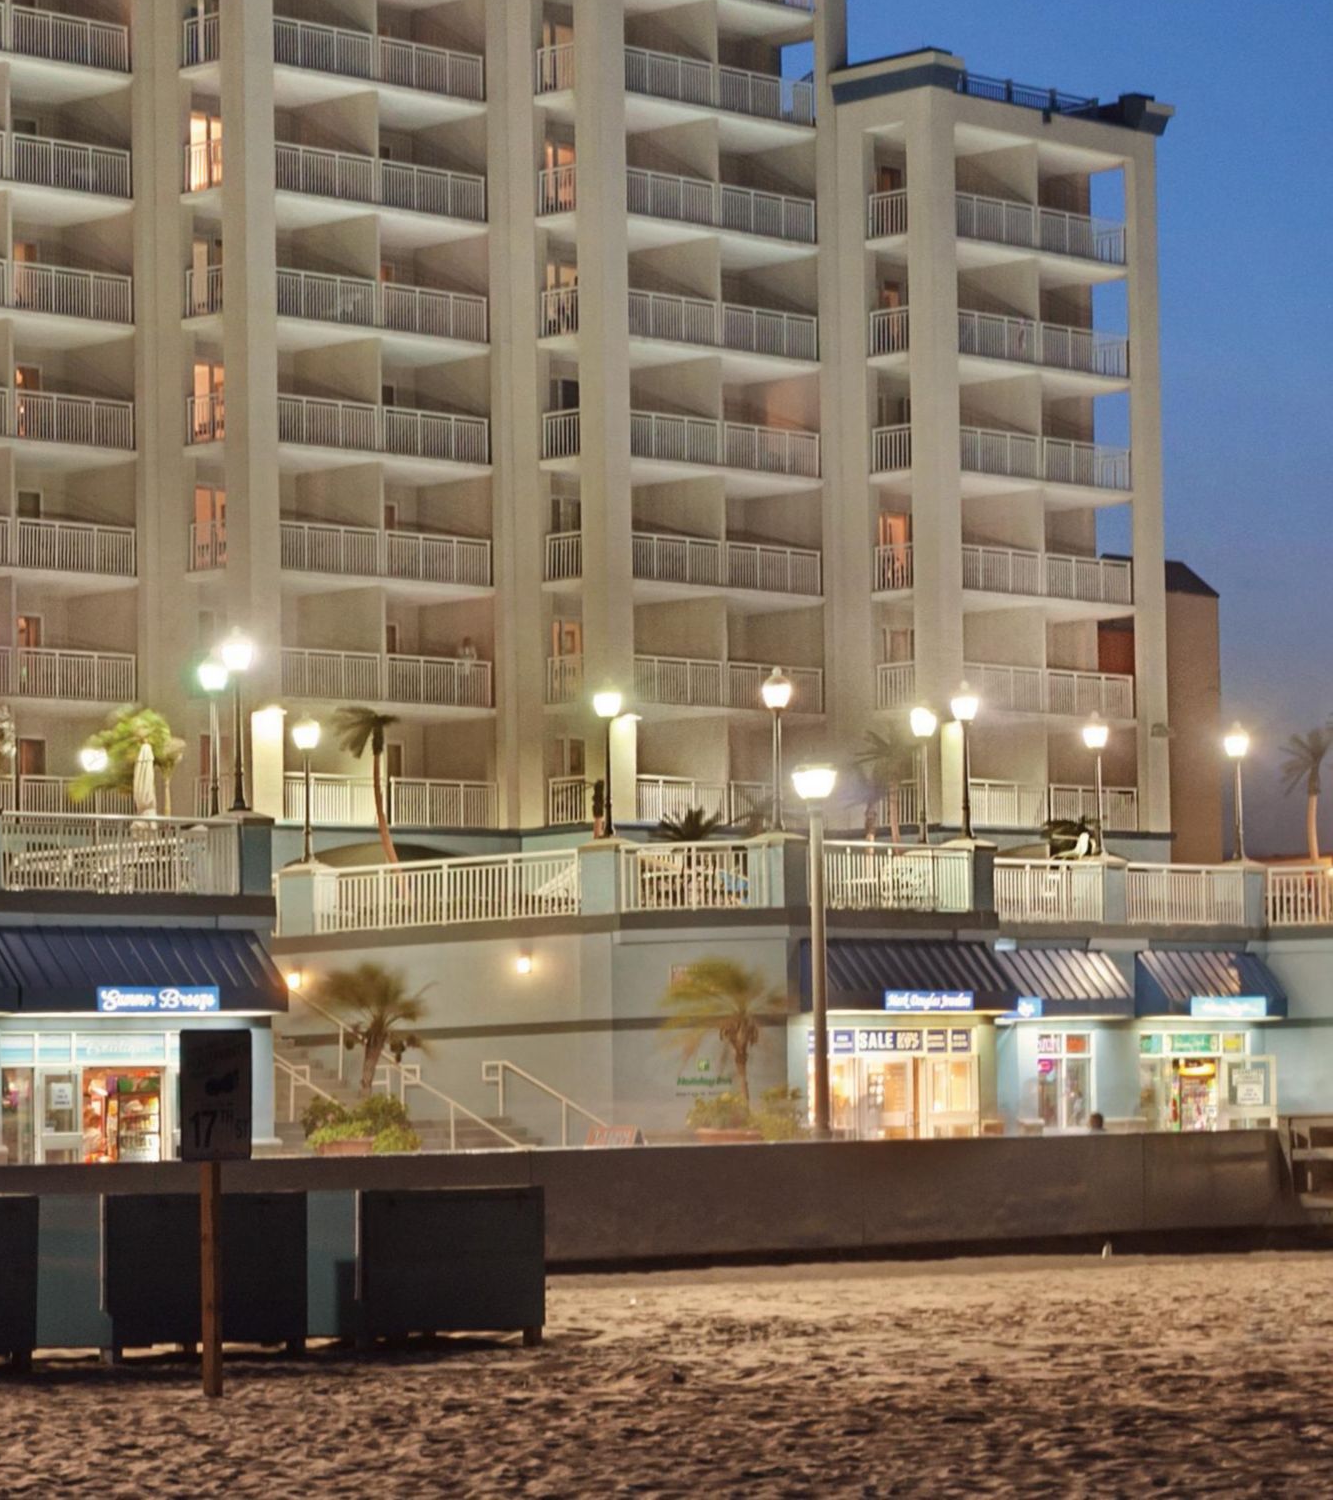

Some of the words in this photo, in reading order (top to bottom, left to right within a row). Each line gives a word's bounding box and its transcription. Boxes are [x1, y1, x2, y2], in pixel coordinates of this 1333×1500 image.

[100, 989, 156, 1011] Summer
[158, 988, 217, 1011] Breeze
[859, 1031, 894, 1049] SALE
